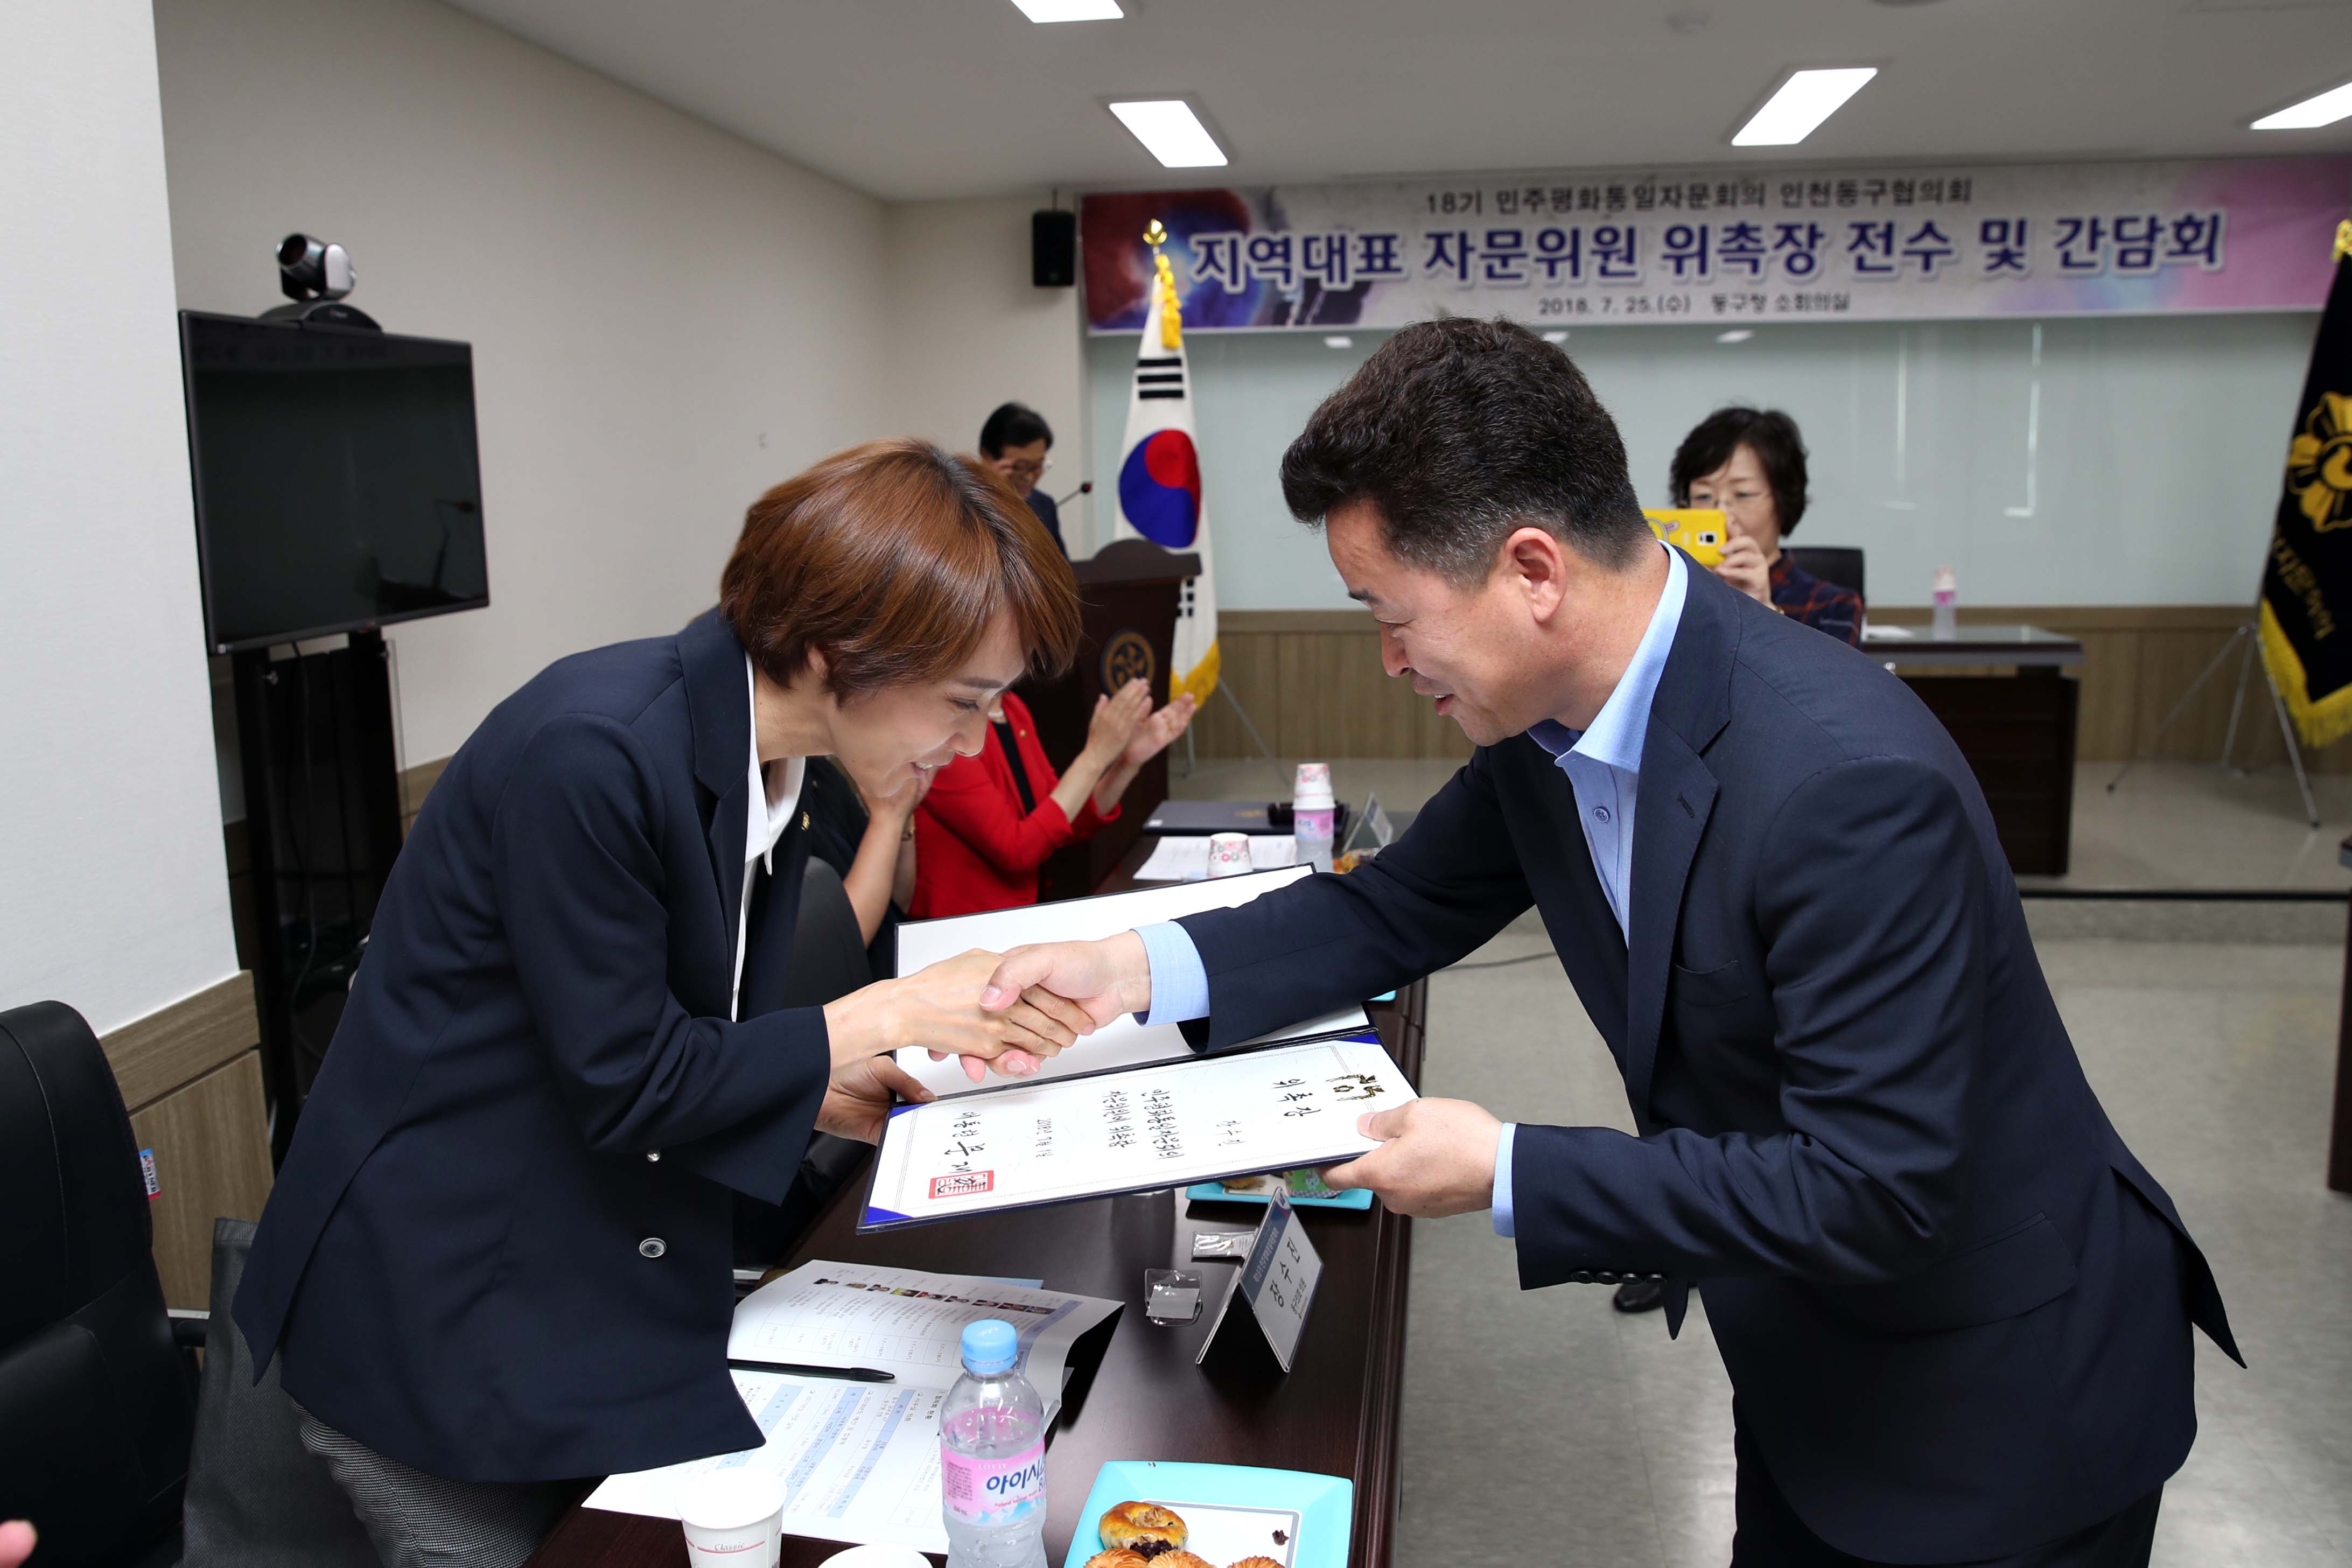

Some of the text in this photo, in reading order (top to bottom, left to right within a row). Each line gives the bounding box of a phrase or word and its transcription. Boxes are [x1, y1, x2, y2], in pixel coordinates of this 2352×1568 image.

[1426, 177, 1972, 215] 18기 민주평화통일자문회의 인천동구협의회
[1194, 214, 2220, 286] 지역대표 자문위원 위촉장 전수 및 간담회
[1538, 297, 1592, 315] 2018.
[1711, 292, 1767, 314] 동구청
[1776, 292, 1851, 313] 소회의실
[952, 1111, 982, 1137] 대통령
[1101, 1091, 1137, 1148] 자문위원에 위촉함
[1142, 1089, 1185, 1159] 민주평화통일자문회의
[715, 1541, 745, 1551] Classic
